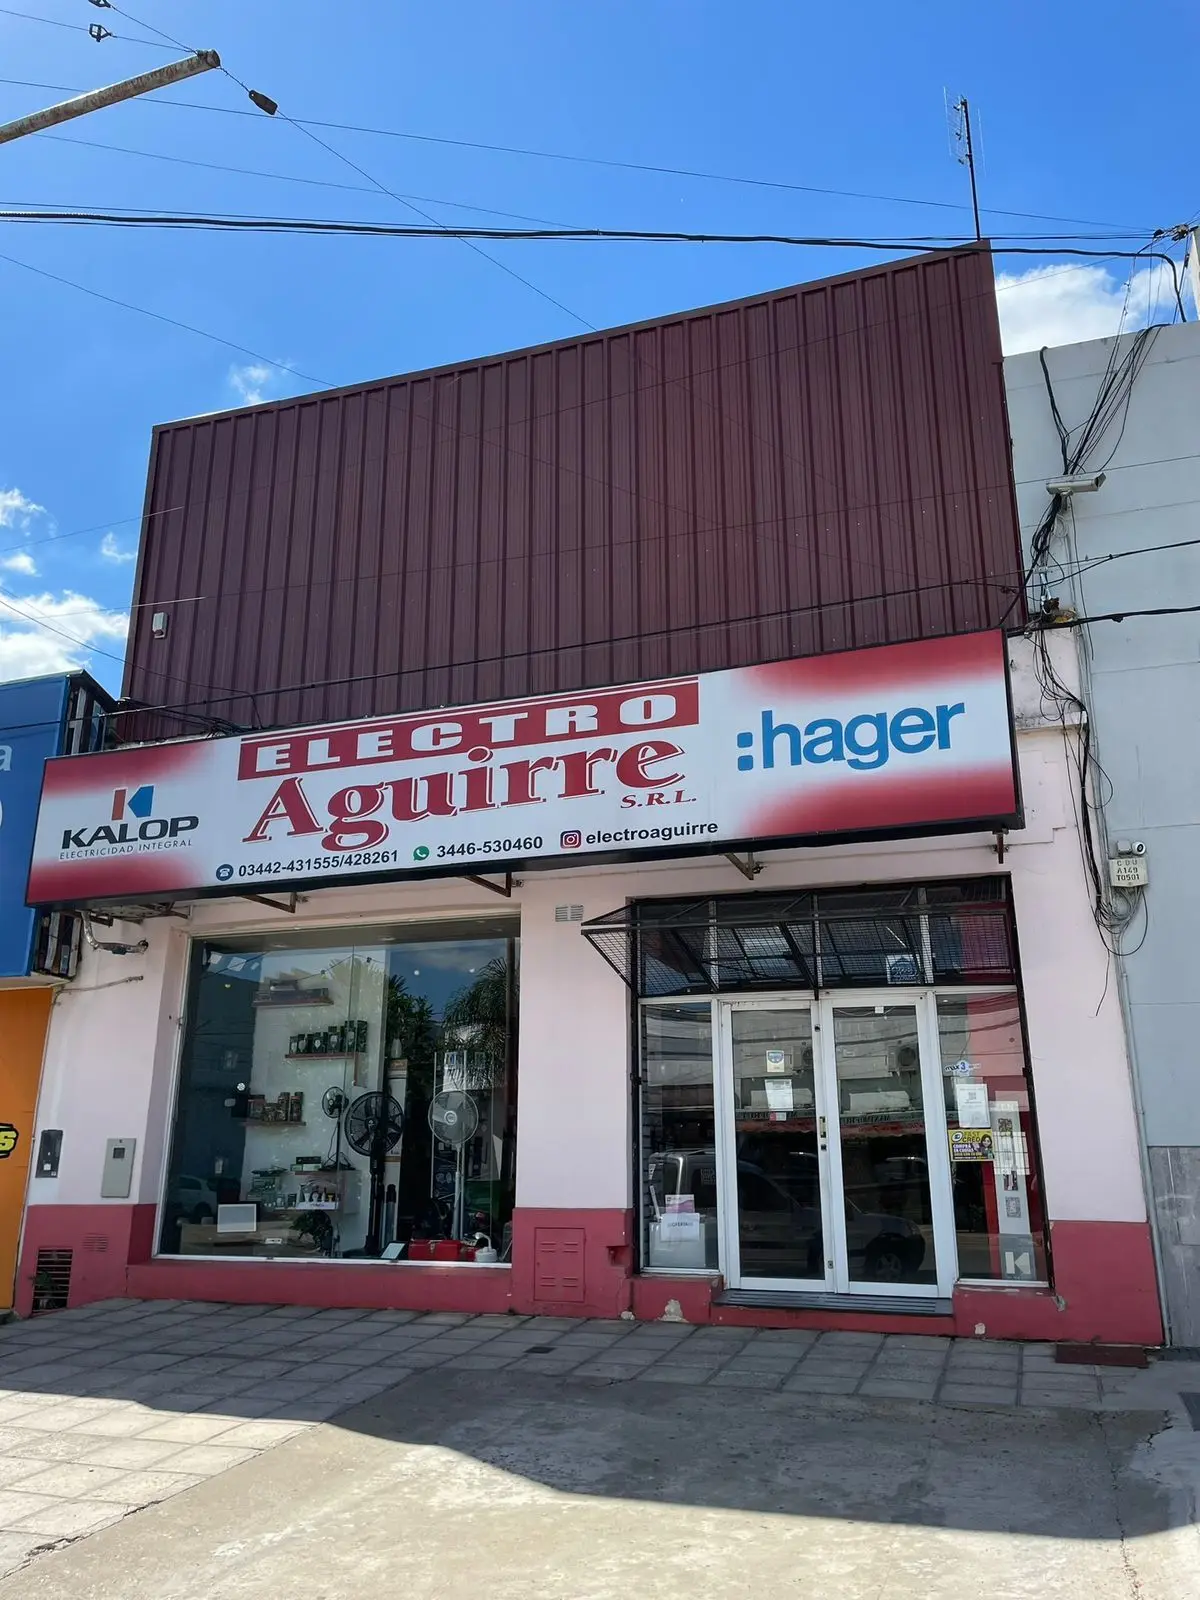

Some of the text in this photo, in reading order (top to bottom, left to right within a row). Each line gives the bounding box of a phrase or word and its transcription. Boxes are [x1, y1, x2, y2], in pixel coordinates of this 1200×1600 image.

[255, 694, 677, 773] ELECTRO
[241, 740, 686, 852] Aguirre
[620, 789, 697, 809] S.R.L.
[62, 815, 199, 849] KALOP
[585, 821, 719, 845] electroaguirre
[59, 840, 193, 860] ELECTRICIDAD INTEGRAL
[436, 836, 544, 858] 3446-530460
[238, 850, 398, 877] 03442-431555/428261
